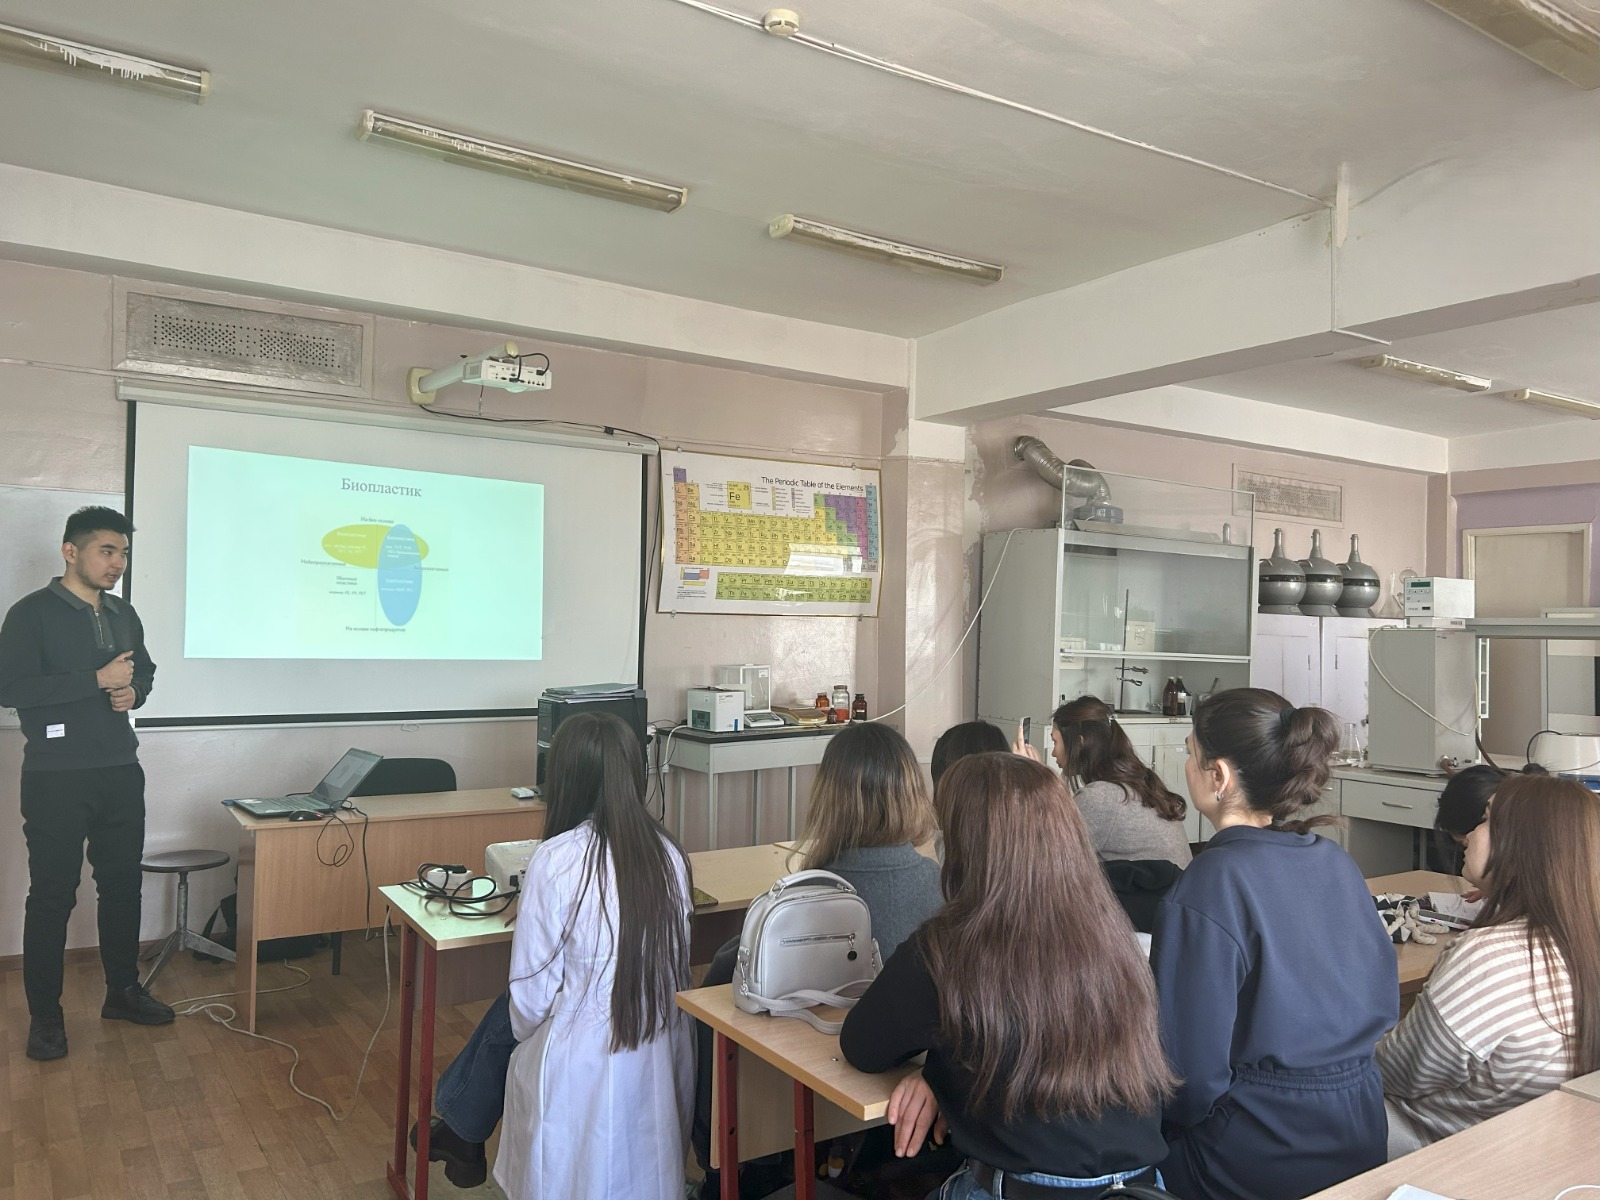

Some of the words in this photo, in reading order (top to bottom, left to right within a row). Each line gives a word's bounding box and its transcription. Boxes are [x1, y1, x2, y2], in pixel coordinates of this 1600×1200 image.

[341, 478, 422, 497] Биопластик
[775, 478, 798, 486] Periodic
[800, 480, 816, 488] Table
[825, 482, 834, 490] the
[836, 482, 863, 492] Elements
[729, 492, 740, 500] Fe
